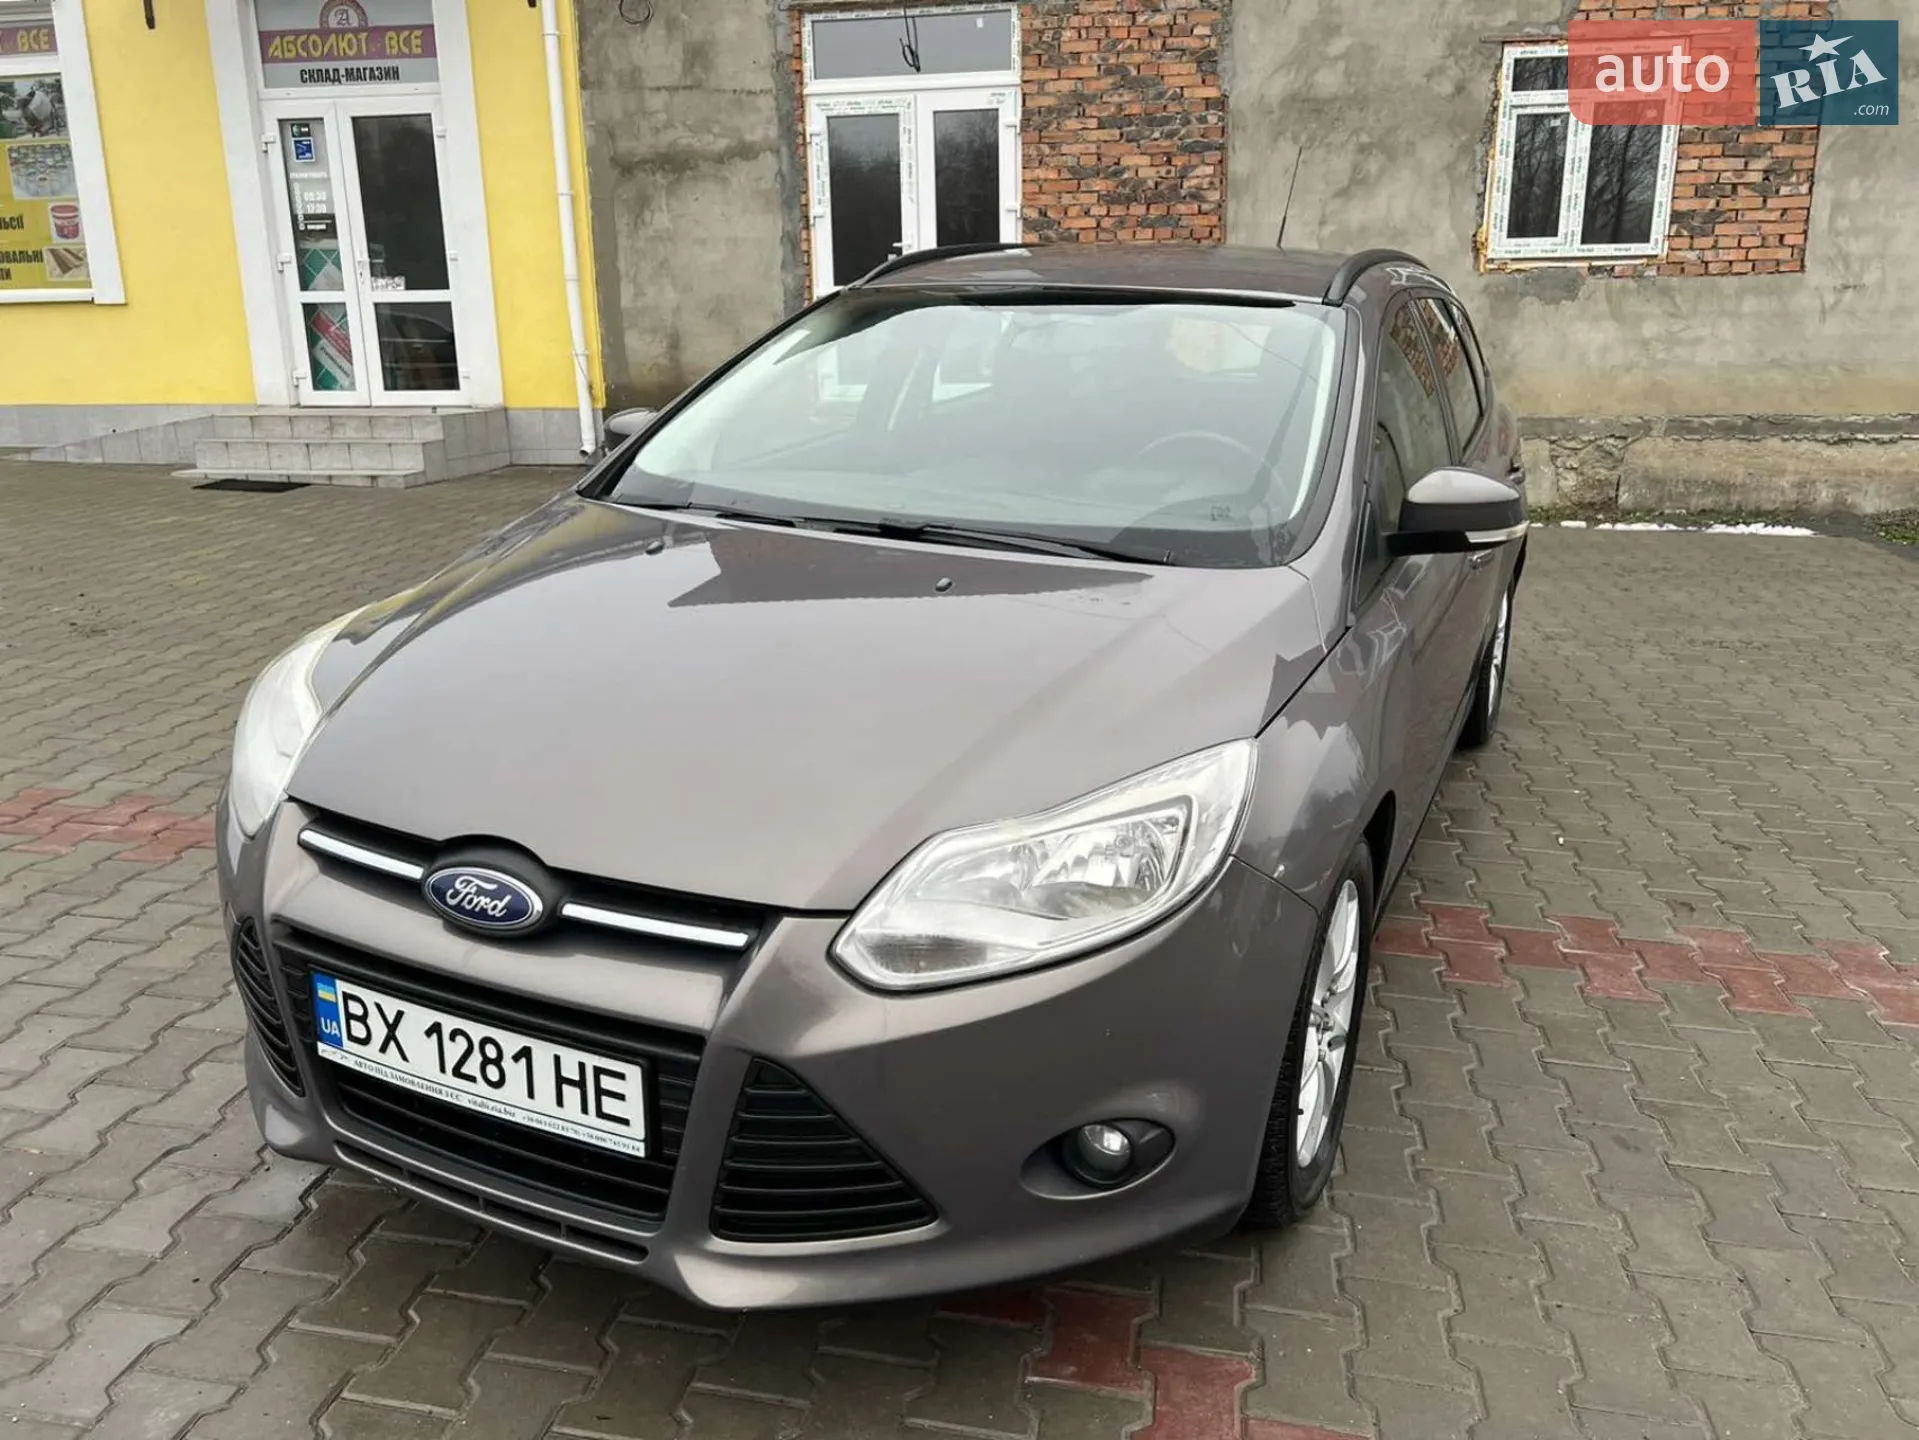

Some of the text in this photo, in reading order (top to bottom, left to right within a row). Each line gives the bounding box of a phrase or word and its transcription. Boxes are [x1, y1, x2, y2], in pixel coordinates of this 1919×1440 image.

[17, 28, 50, 51] ВСЕ
[268, 31, 370, 59] АБСОЛЮТ
[385, 29, 424, 56] ВСЕ
[299, 65, 400, 85] СКЛАД-МАГАЗИН
[445, 875, 512, 917] Ford
[322, 1016, 341, 1037] UA
[341, 990, 631, 1128] BX 1281 HE
